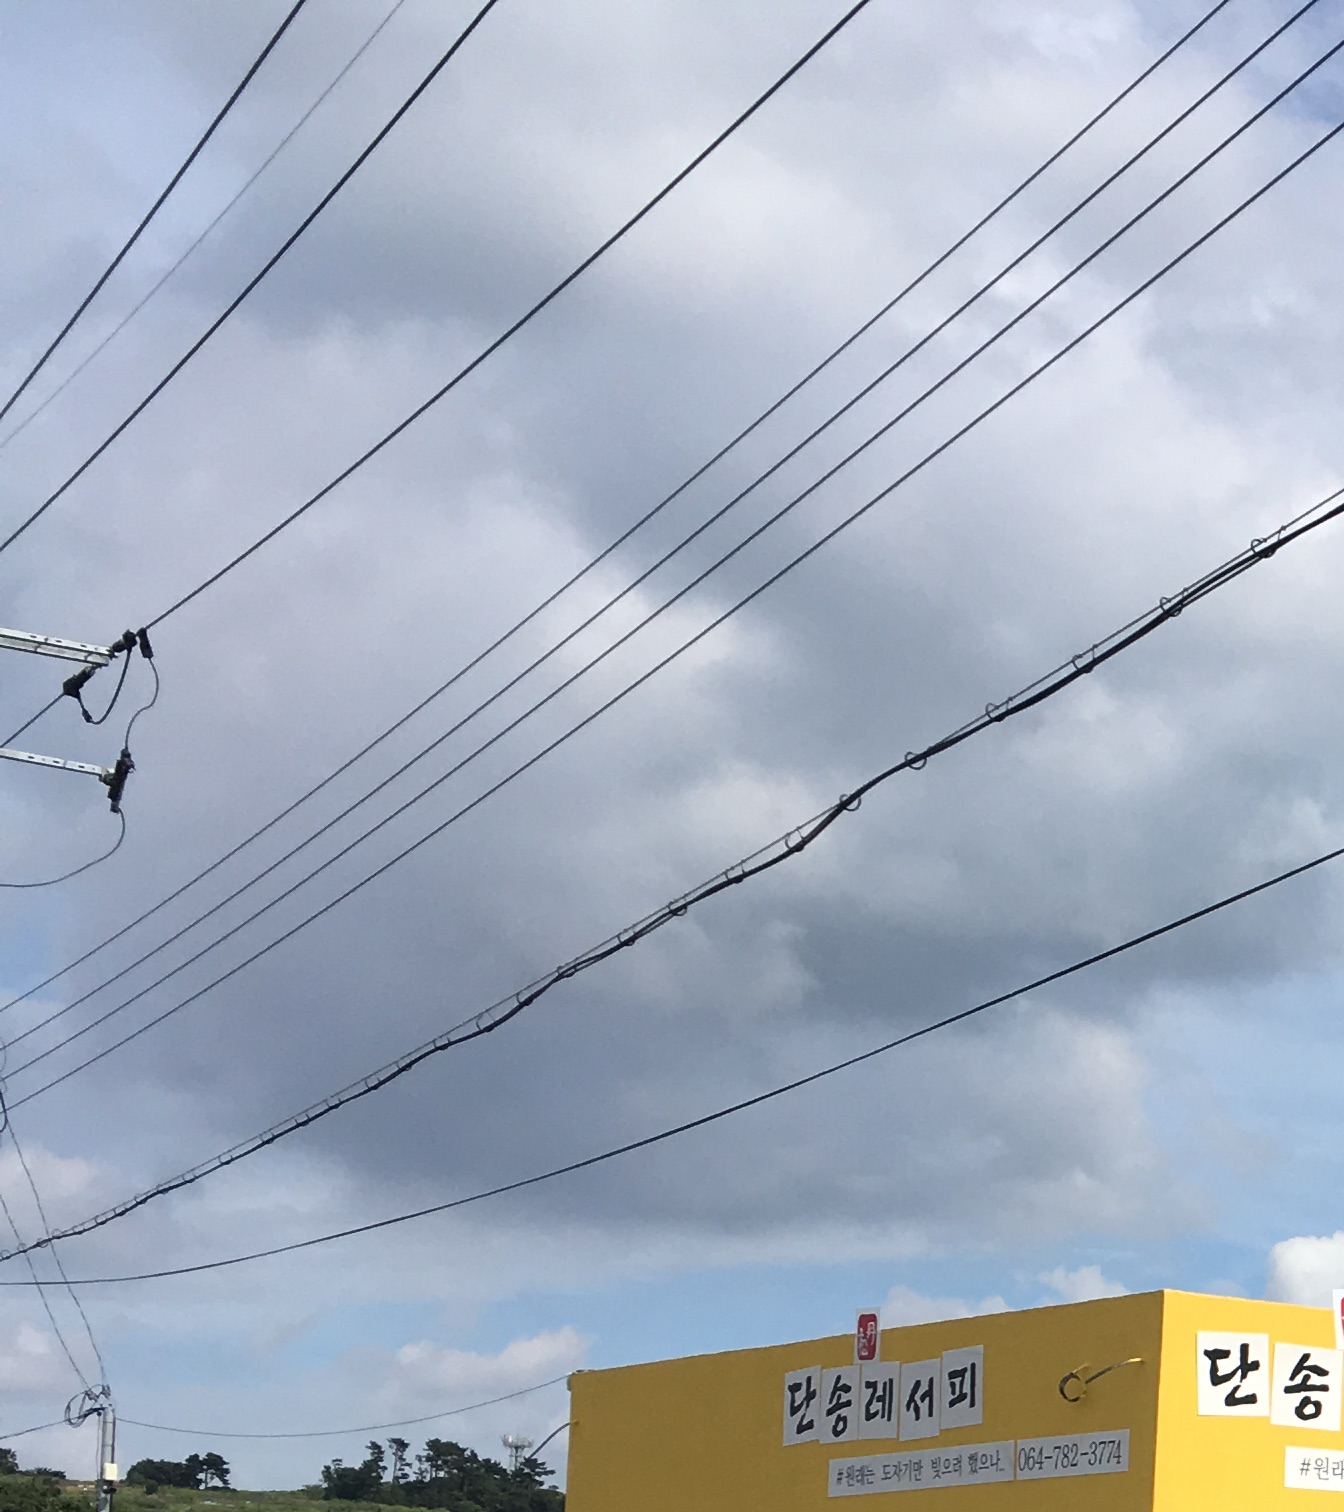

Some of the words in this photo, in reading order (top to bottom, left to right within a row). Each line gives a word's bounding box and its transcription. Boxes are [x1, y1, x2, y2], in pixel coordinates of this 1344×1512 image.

[788, 1362, 976, 1437] 단송레서피
[836, 1464, 875, 1487] #원래는
[880, 1459, 923, 1482] 도자기만
[930, 1454, 963, 1480] 빚으려
[1018, 1439, 1122, 1472] 064-782-3774
